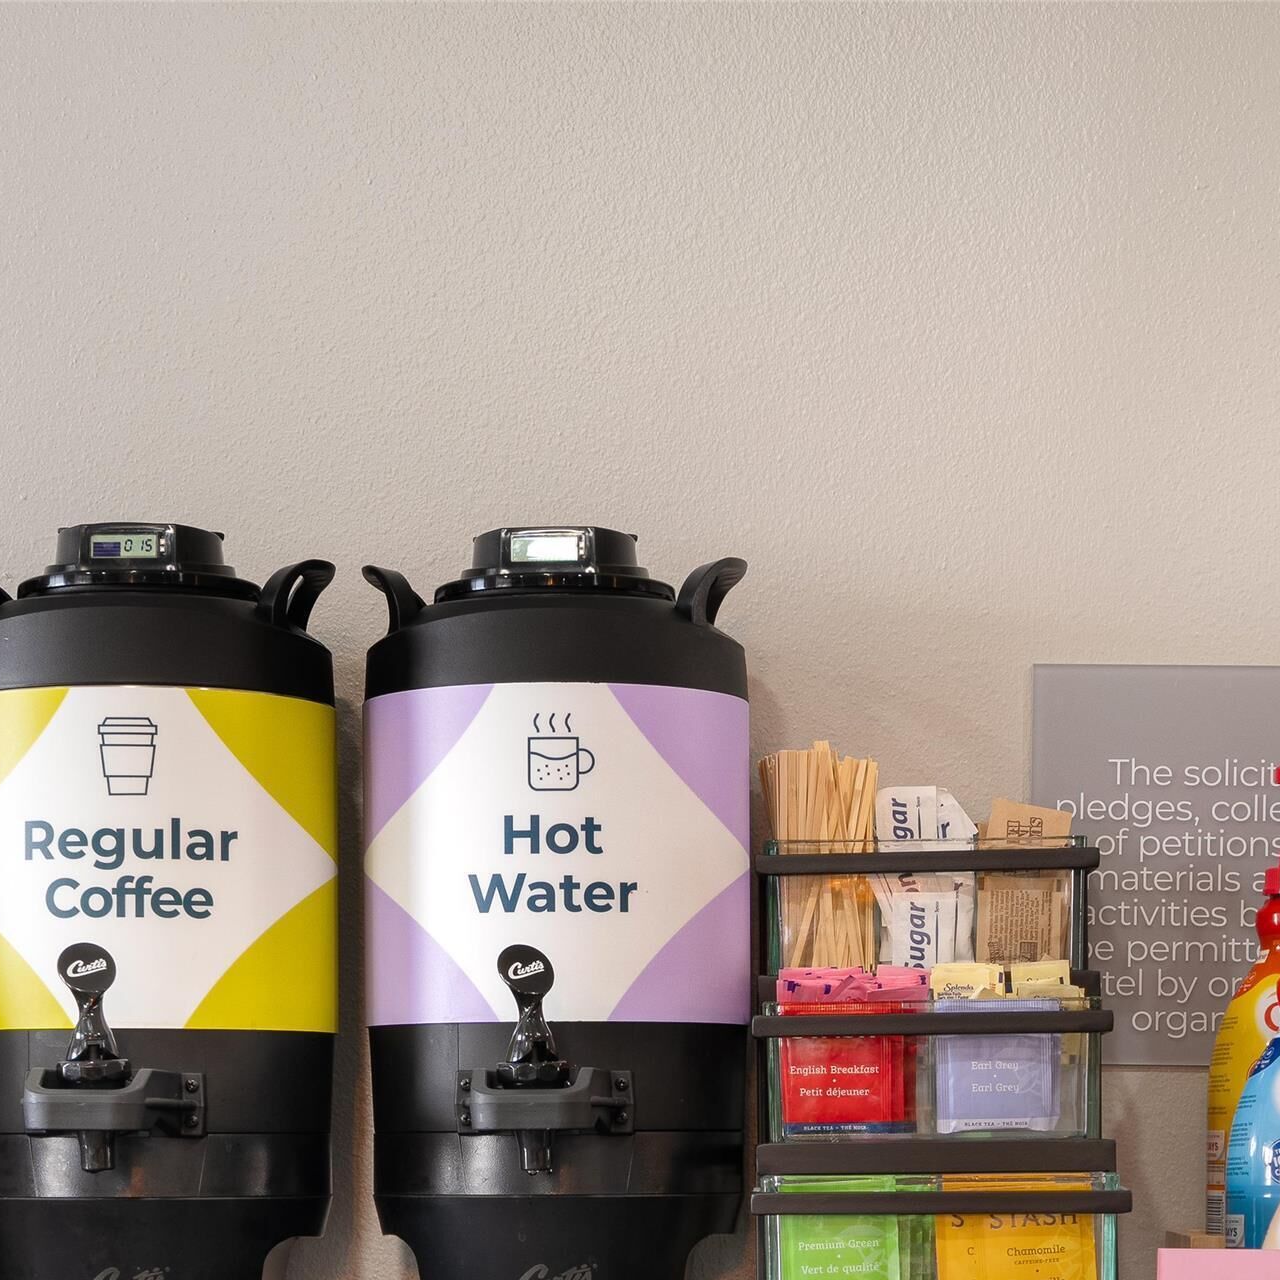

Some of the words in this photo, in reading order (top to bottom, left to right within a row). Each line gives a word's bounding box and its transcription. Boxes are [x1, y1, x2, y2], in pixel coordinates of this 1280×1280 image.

[1108, 759, 1173, 786] The
[24, 818, 238, 870] Regular
[503, 814, 604, 855] Hot
[1095, 828, 1129, 856] of
[1087, 864, 1241, 893] materials
[45, 875, 214, 919] Coffee
[468, 873, 637, 913] Water
[1087, 898, 1227, 927] activities
[1126, 934, 1260, 967] permitt
[66, 958, 108, 980] Curtis
[508, 960, 545, 980] Curtis
[1102, 968, 1144, 997] tel
[1157, 969, 1200, 1003] by
[790, 1066, 827, 1076] English
[830, 1065, 880, 1074] Breakfast
[971, 1061, 992, 1071] Earl
[995, 1061, 1019, 1074] Grey
[800, 1088, 822, 1097] Petit
[826, 1087, 870, 1098] déjeuner
[971, 1083, 992, 1093] Earl
[996, 1083, 1020, 1095] Grey
[798, 1240, 844, 1252] Premium
[847, 1238, 880, 1249] Green
[1007, 1245, 1065, 1256] Chamomile
[801, 1264, 824, 1275] Vert
[827, 1264, 840, 1274] de
[842, 1261, 880, 1277] qualité
